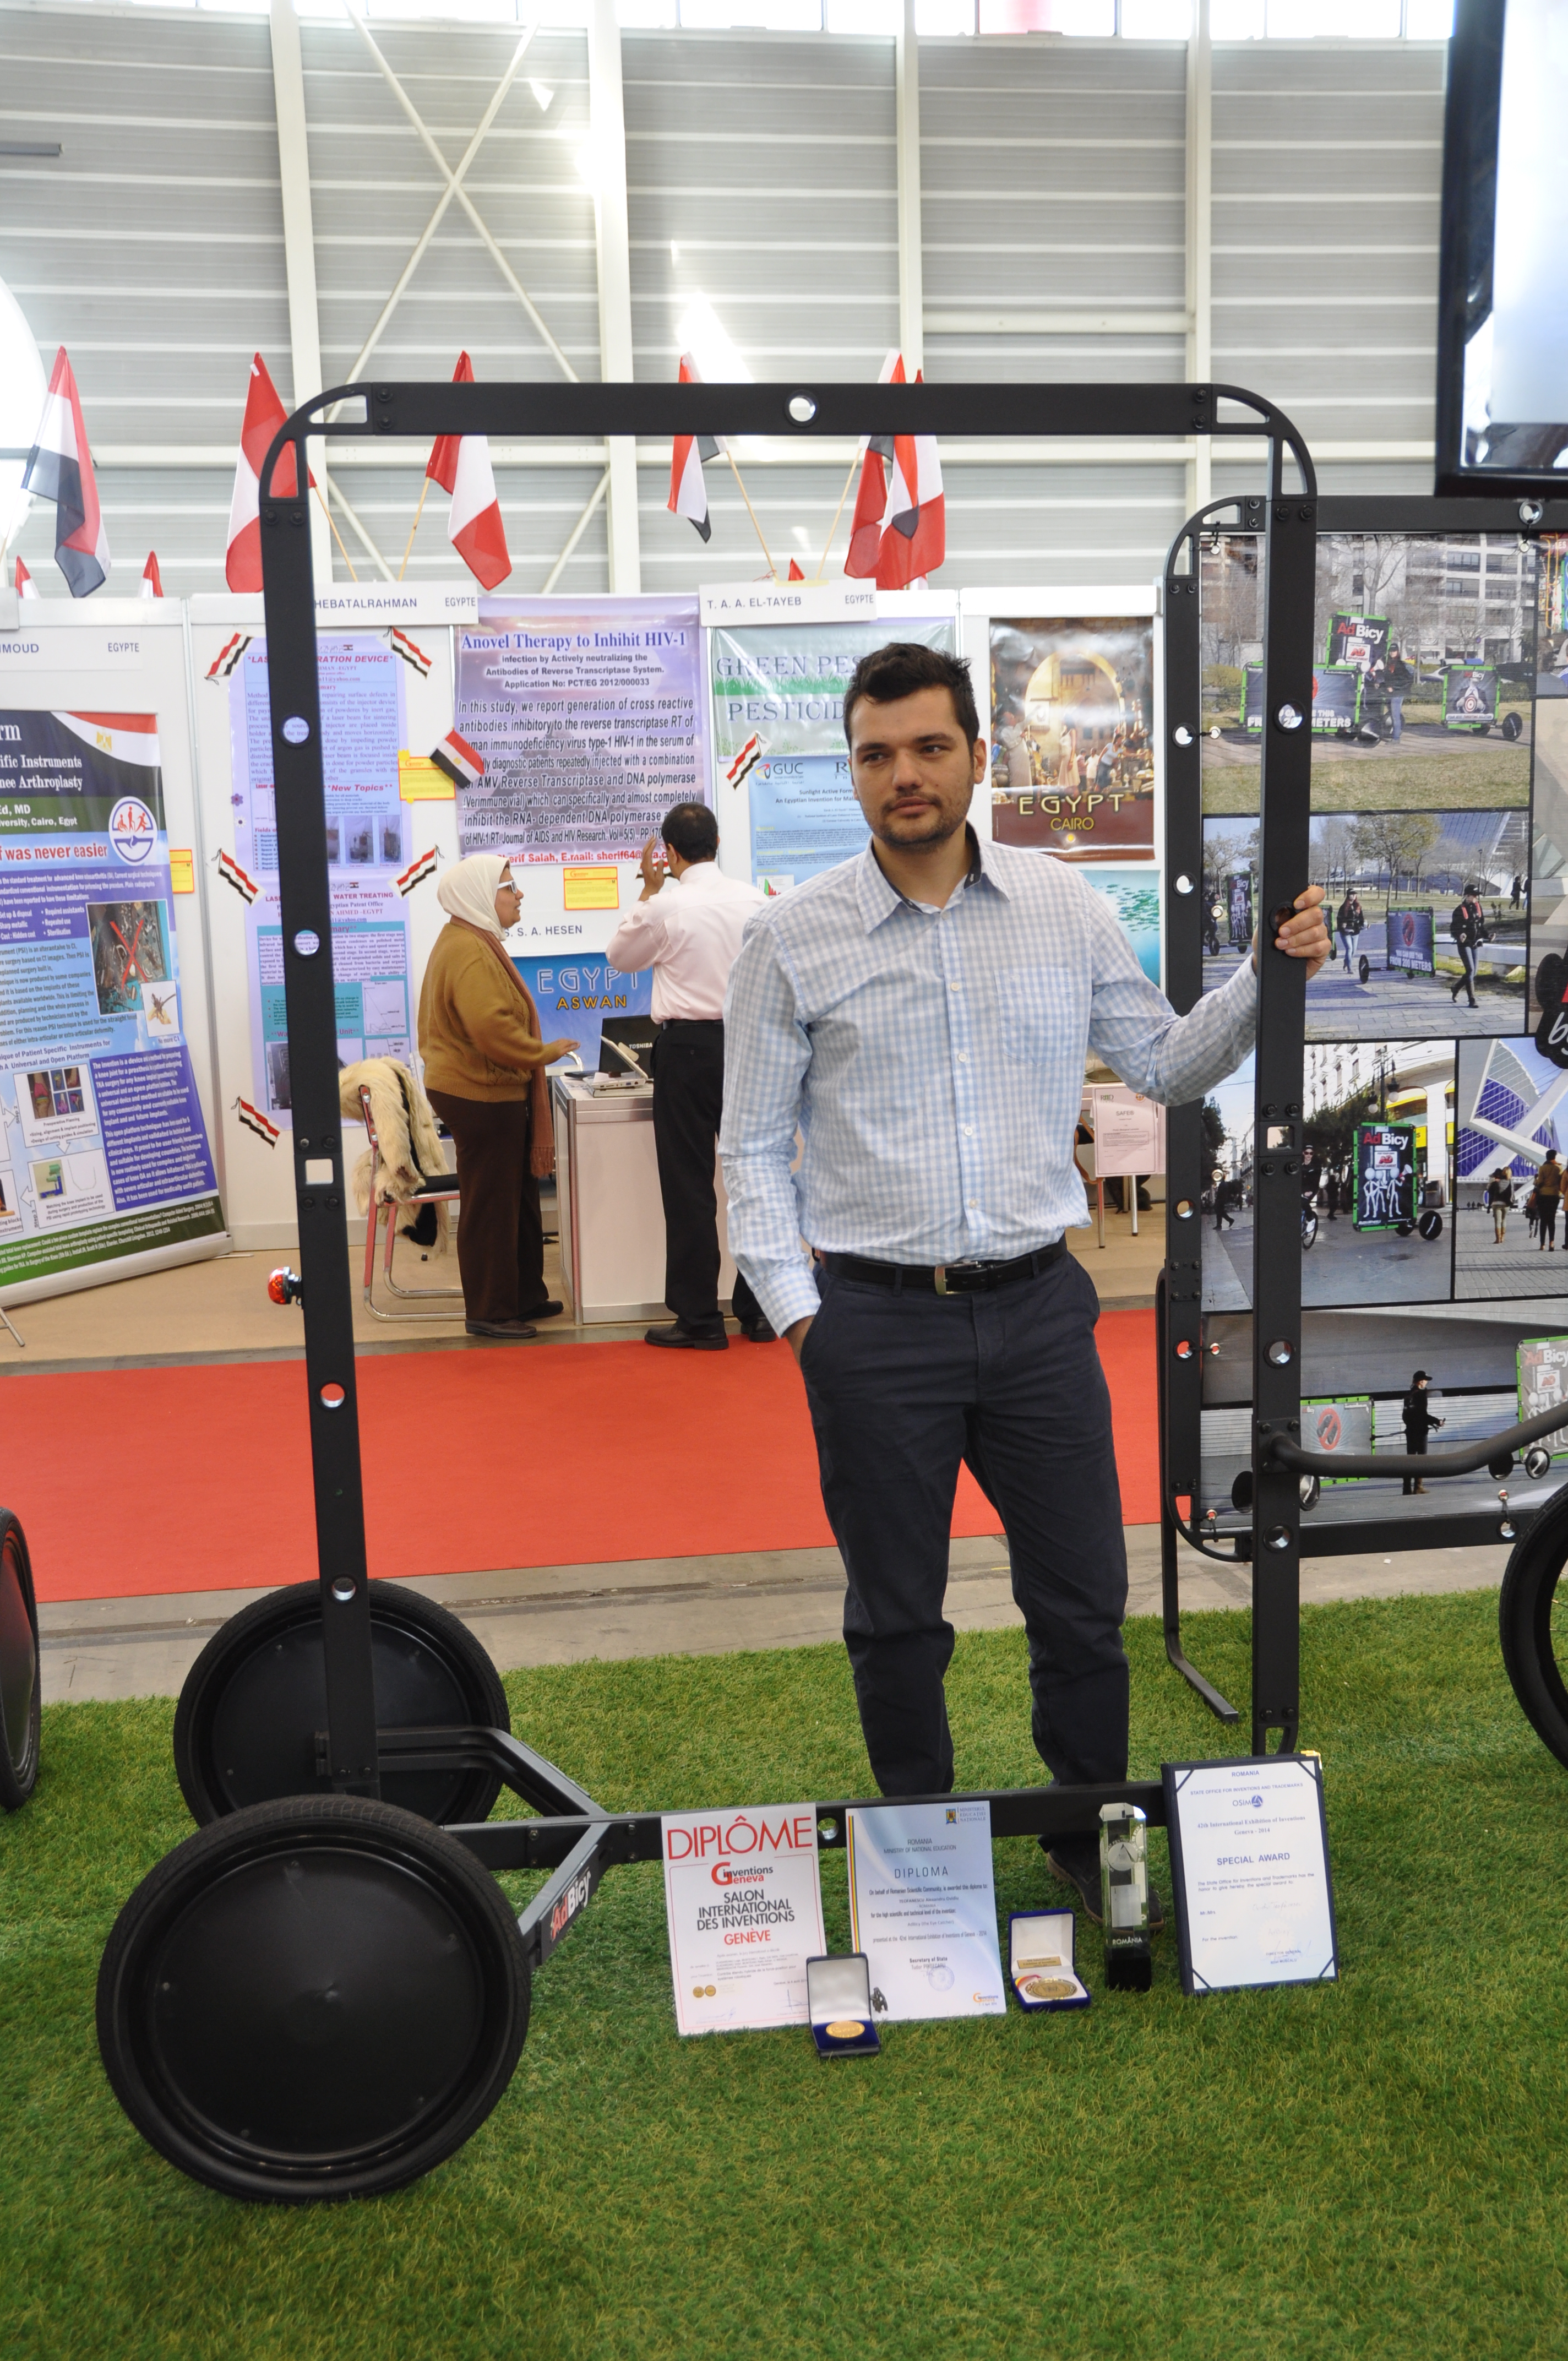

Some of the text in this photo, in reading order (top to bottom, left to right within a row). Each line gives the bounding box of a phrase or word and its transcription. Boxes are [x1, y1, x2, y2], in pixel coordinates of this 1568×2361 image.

[314, 598, 417, 609] HEBATALRAHMAN
[445, 597, 476, 607] EGYPTE
[707, 596, 802, 609] T. A. A. EL-TAYEB
[845, 594, 874, 604] EGYPTE
[1337, 622, 1385, 644] AdBicy
[0, 643, 39, 654] MOUD
[107, 643, 139, 652] EGYPTE
[462, 634, 509, 649] Anovel
[514, 634, 572, 651] Therapy
[576, 634, 590, 647] to
[645, 632, 685, 646] HIV-1
[540, 655, 549, 664] by
[551, 654, 584, 663] Actively
[586, 654, 633, 662] neutralizing
[635, 653, 647, 661] the
[716, 656, 807, 676] GREEN
[486, 667, 529, 676] Antibodies
[575, 666, 630, 676] Transcriptase
[633, 666, 665, 675] System.
[504, 680, 550, 689] Application
[568, 679, 597, 687] PCT/EG
[600, 678, 650, 686] 2012/000033
[459, 697, 693, 715] In this study, we report generation of cross reactive
[728, 701, 846, 721] PESTICID
[459, 715, 694, 734] antibodies inhibitory to the reverse transcriptase RT of
[491, 733, 694, 752] immunodeficiency virus type-1 HIV-1 in the serum of
[20, 754, 83, 769] Instruments
[773, 762, 804, 775] GUC
[19, 775, 83, 791] Arthroplasty
[477, 775, 498, 788] AMV
[501, 775, 538, 788] Reverse
[542, 774, 604, 789] Transcriptase
[607, 773, 623, 785] and
[627, 772, 645, 785] DNA
[647, 772, 696, 787] polymerase
[463, 790, 696, 810] (Verimmune vial) which can specifically and almost completely
[1019, 793, 1125, 815] EGYPT
[14, 804, 31, 815] MD
[31, 816, 78, 827] Cairo, Egypt
[1050, 817, 1095, 831] CAIRO
[5, 842, 107, 861] was never easier
[528, 853, 558, 863] Salah,
[517, 927, 527, 937] S.
[531, 927, 541, 936] A.
[545, 925, 582, 935] HESEN
[556, 994, 627, 1010] ASWAN
[21, 1048, 43, 1058] Patient
[44, 1045, 67, 1056] Specific
[69, 1041, 102, 1052] Instruments
[51, 1052, 90, 1065] Open Platform
[1363, 1132, 1409, 1150] AdBicy
[1210, 1820, 1244, 1828] International
[667, 1814, 813, 1860] DIPLÔME
[1217, 1852, 1291, 1865] SPECIAL AWARD
[723, 1865, 774, 1878] inventions
[894, 1865, 949, 1879] DIPLOMA
[723, 1889, 764, 1904] SALON
[551, 1870, 591, 1943] AdBicy
[699, 1898, 792, 1919] INTERNATIONAL
[697, 1910, 795, 1931] DES INVENTIONS
[724, 1928, 771, 1946] GENÈVE
[1112, 1936, 1143, 1945] ROMÂNIA
